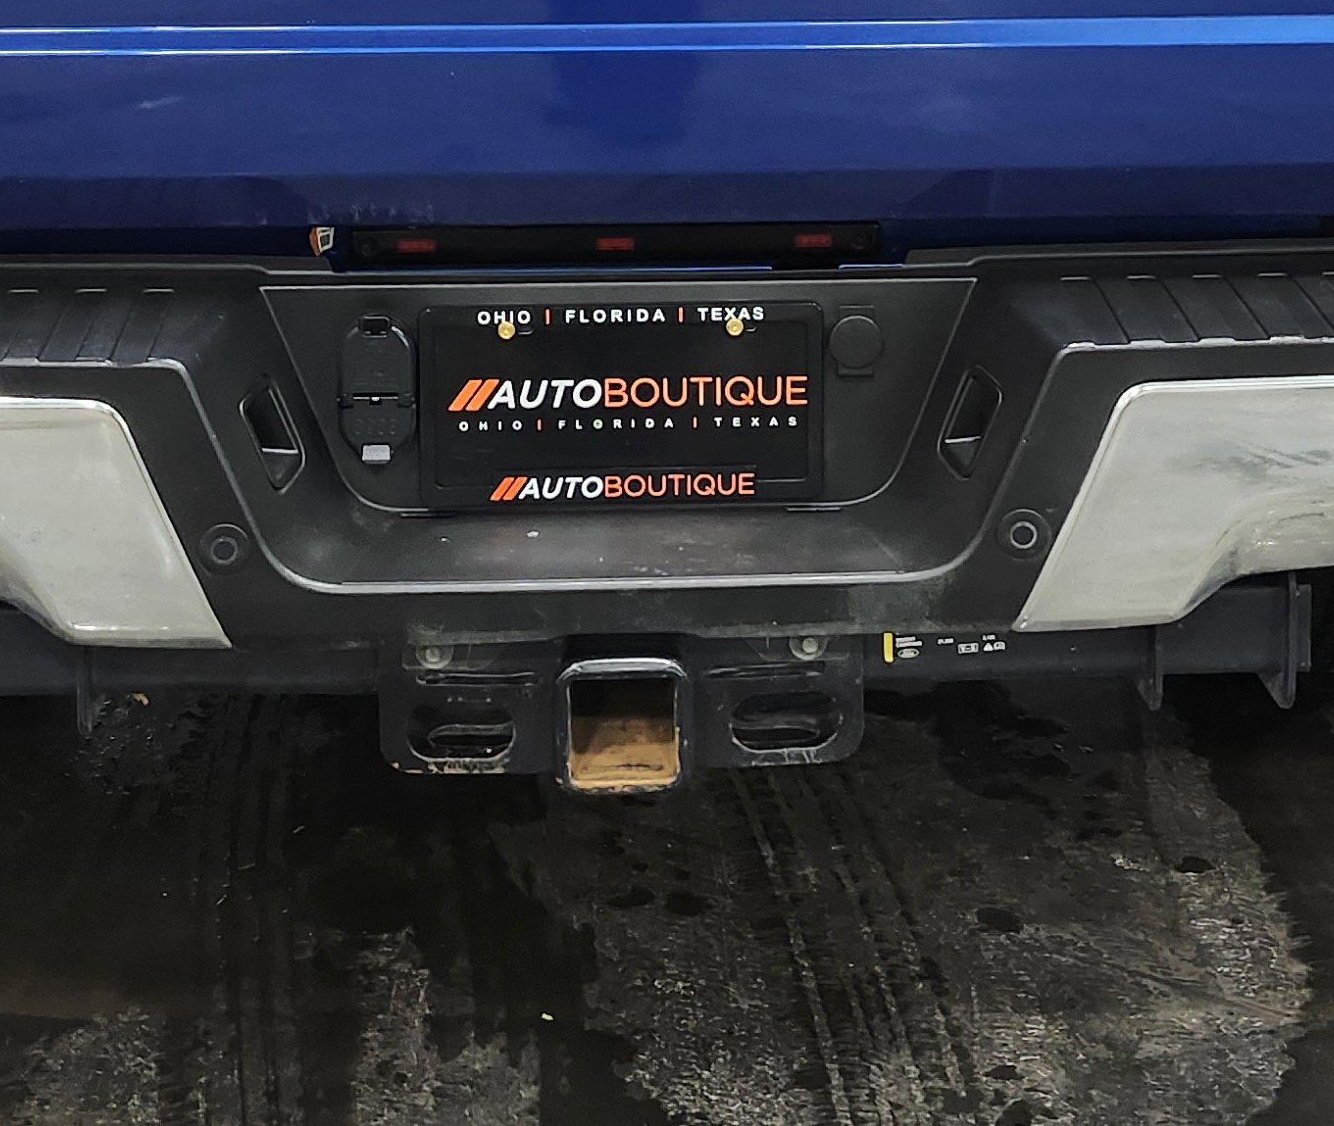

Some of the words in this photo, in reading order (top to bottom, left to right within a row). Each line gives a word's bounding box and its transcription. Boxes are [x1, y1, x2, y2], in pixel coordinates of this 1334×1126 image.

[477, 310, 532, 325] OHIO
[564, 308, 666, 324] FLORIDA
[697, 306, 765, 322] TEXAS
[487, 375, 808, 410] AUTOBOUTIQUE
[458, 419, 523, 431] OHIO
[558, 418, 675, 430] FLORIDA
[713, 416, 798, 427] TEXAS
[518, 472, 755, 500] AUTOBOUTIQUE
